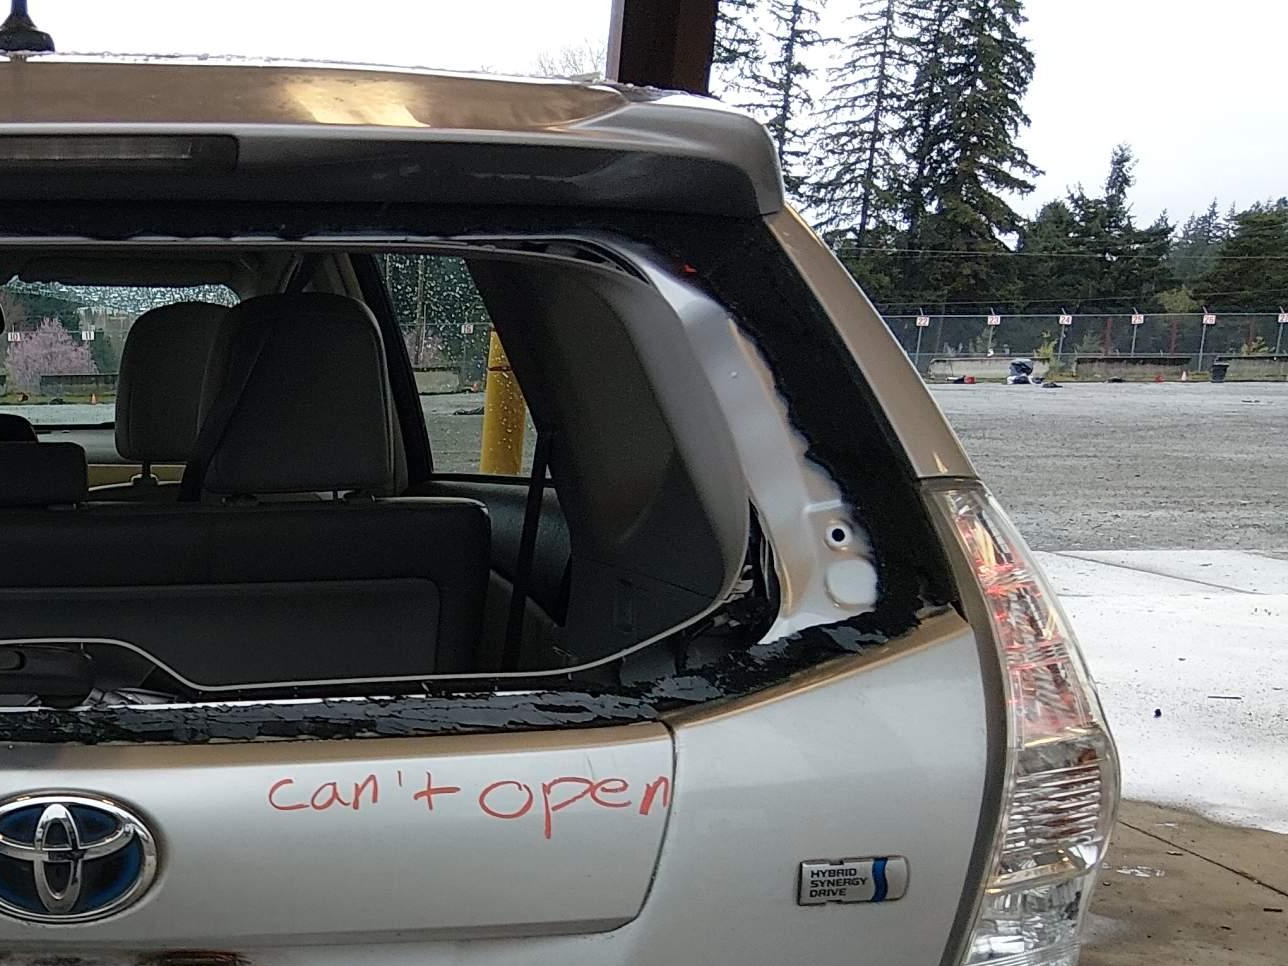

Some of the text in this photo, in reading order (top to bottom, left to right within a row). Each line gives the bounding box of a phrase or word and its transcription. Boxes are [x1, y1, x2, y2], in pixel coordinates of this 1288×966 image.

[268, 771, 670, 839] can't open
[810, 868, 857, 878] HYBRID
[810, 877, 869, 888] SYNERGY
[809, 888, 847, 897] DRIVE
